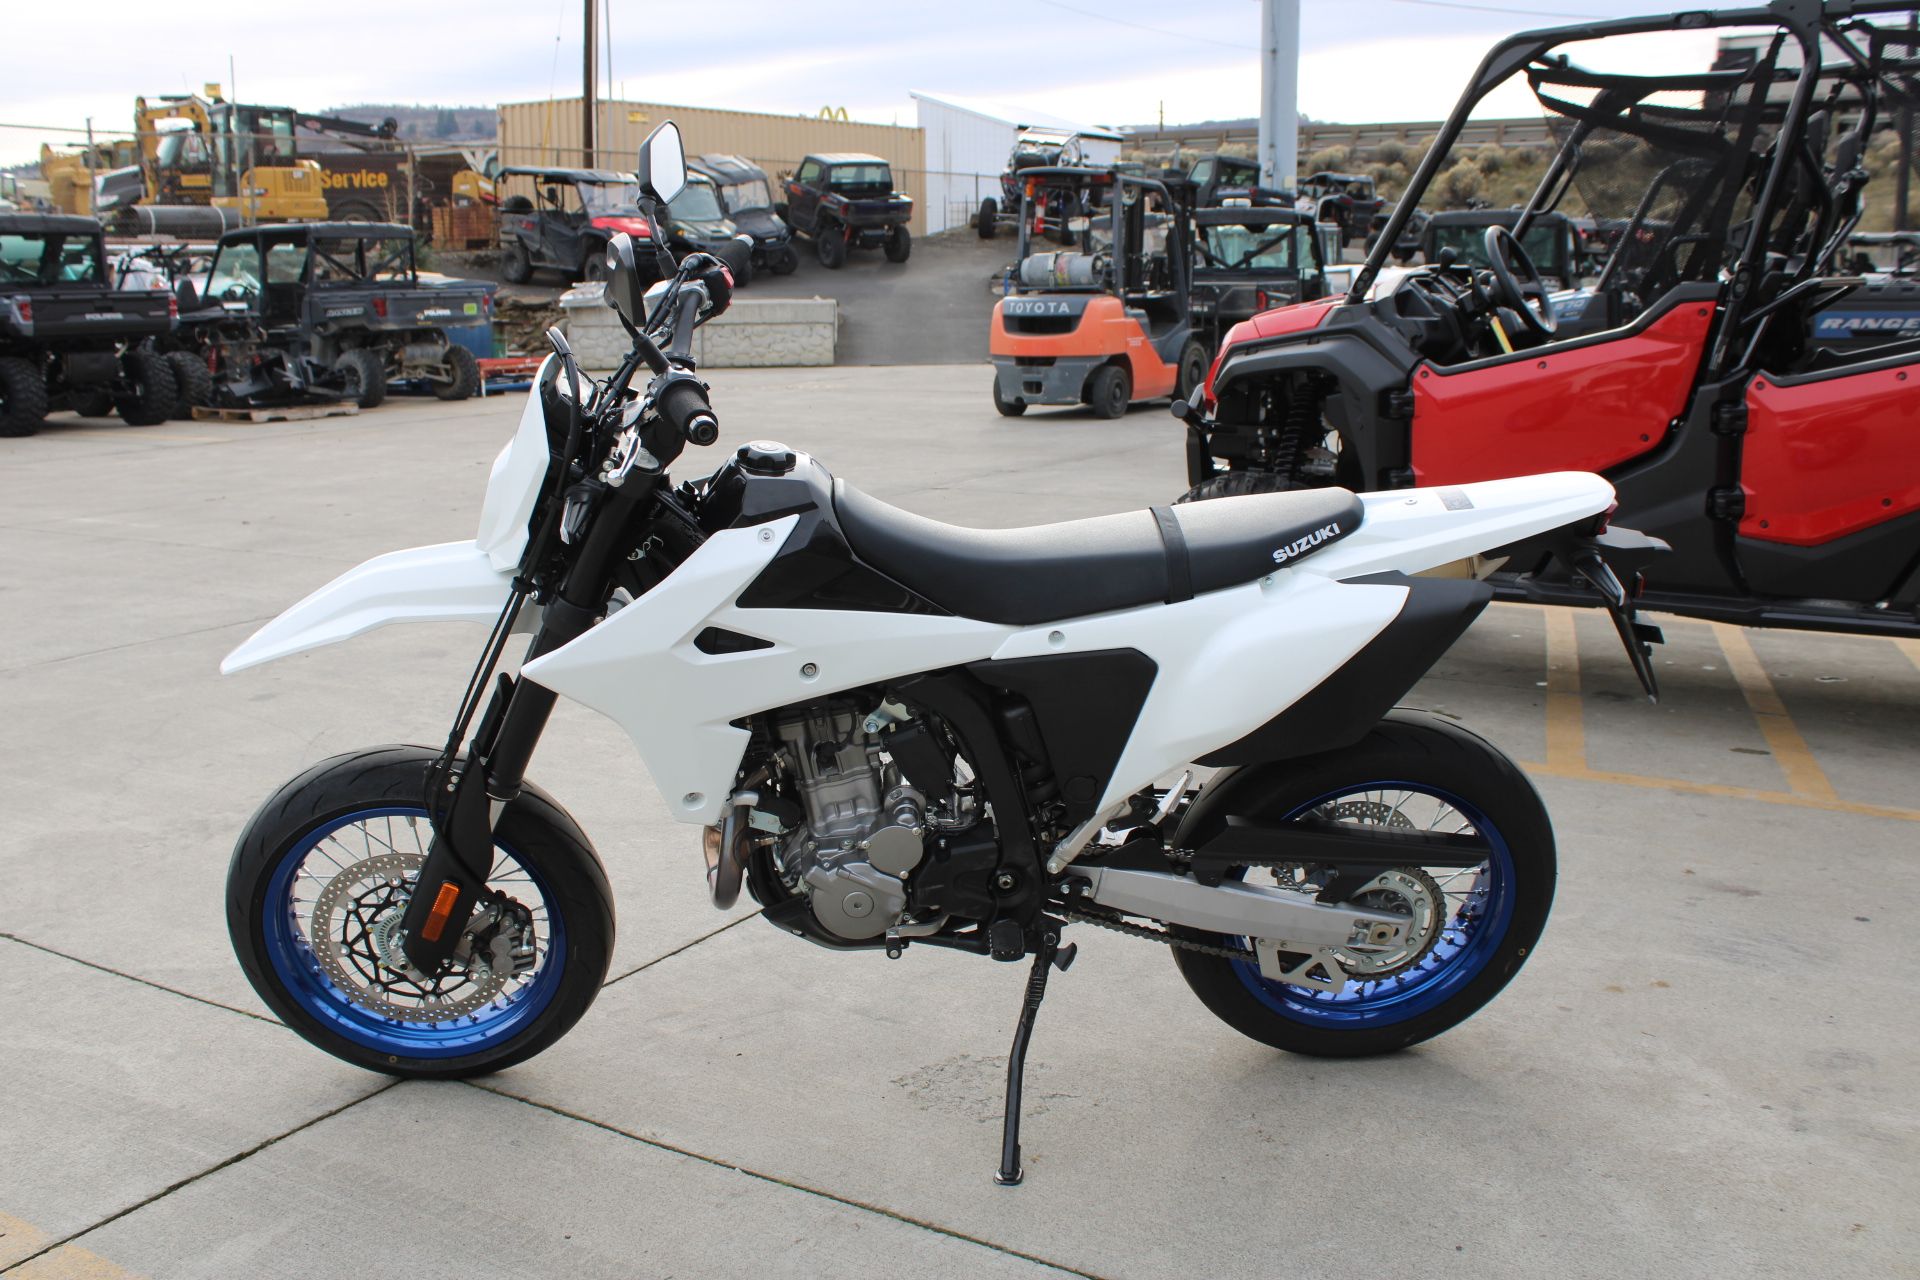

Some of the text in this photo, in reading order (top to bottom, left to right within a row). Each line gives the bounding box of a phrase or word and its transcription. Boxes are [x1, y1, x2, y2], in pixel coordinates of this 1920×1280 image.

[320, 169, 388, 189] Service
[1009, 302, 1070, 313] TOYOTA
[1272, 522, 1341, 564] SUZUKI
